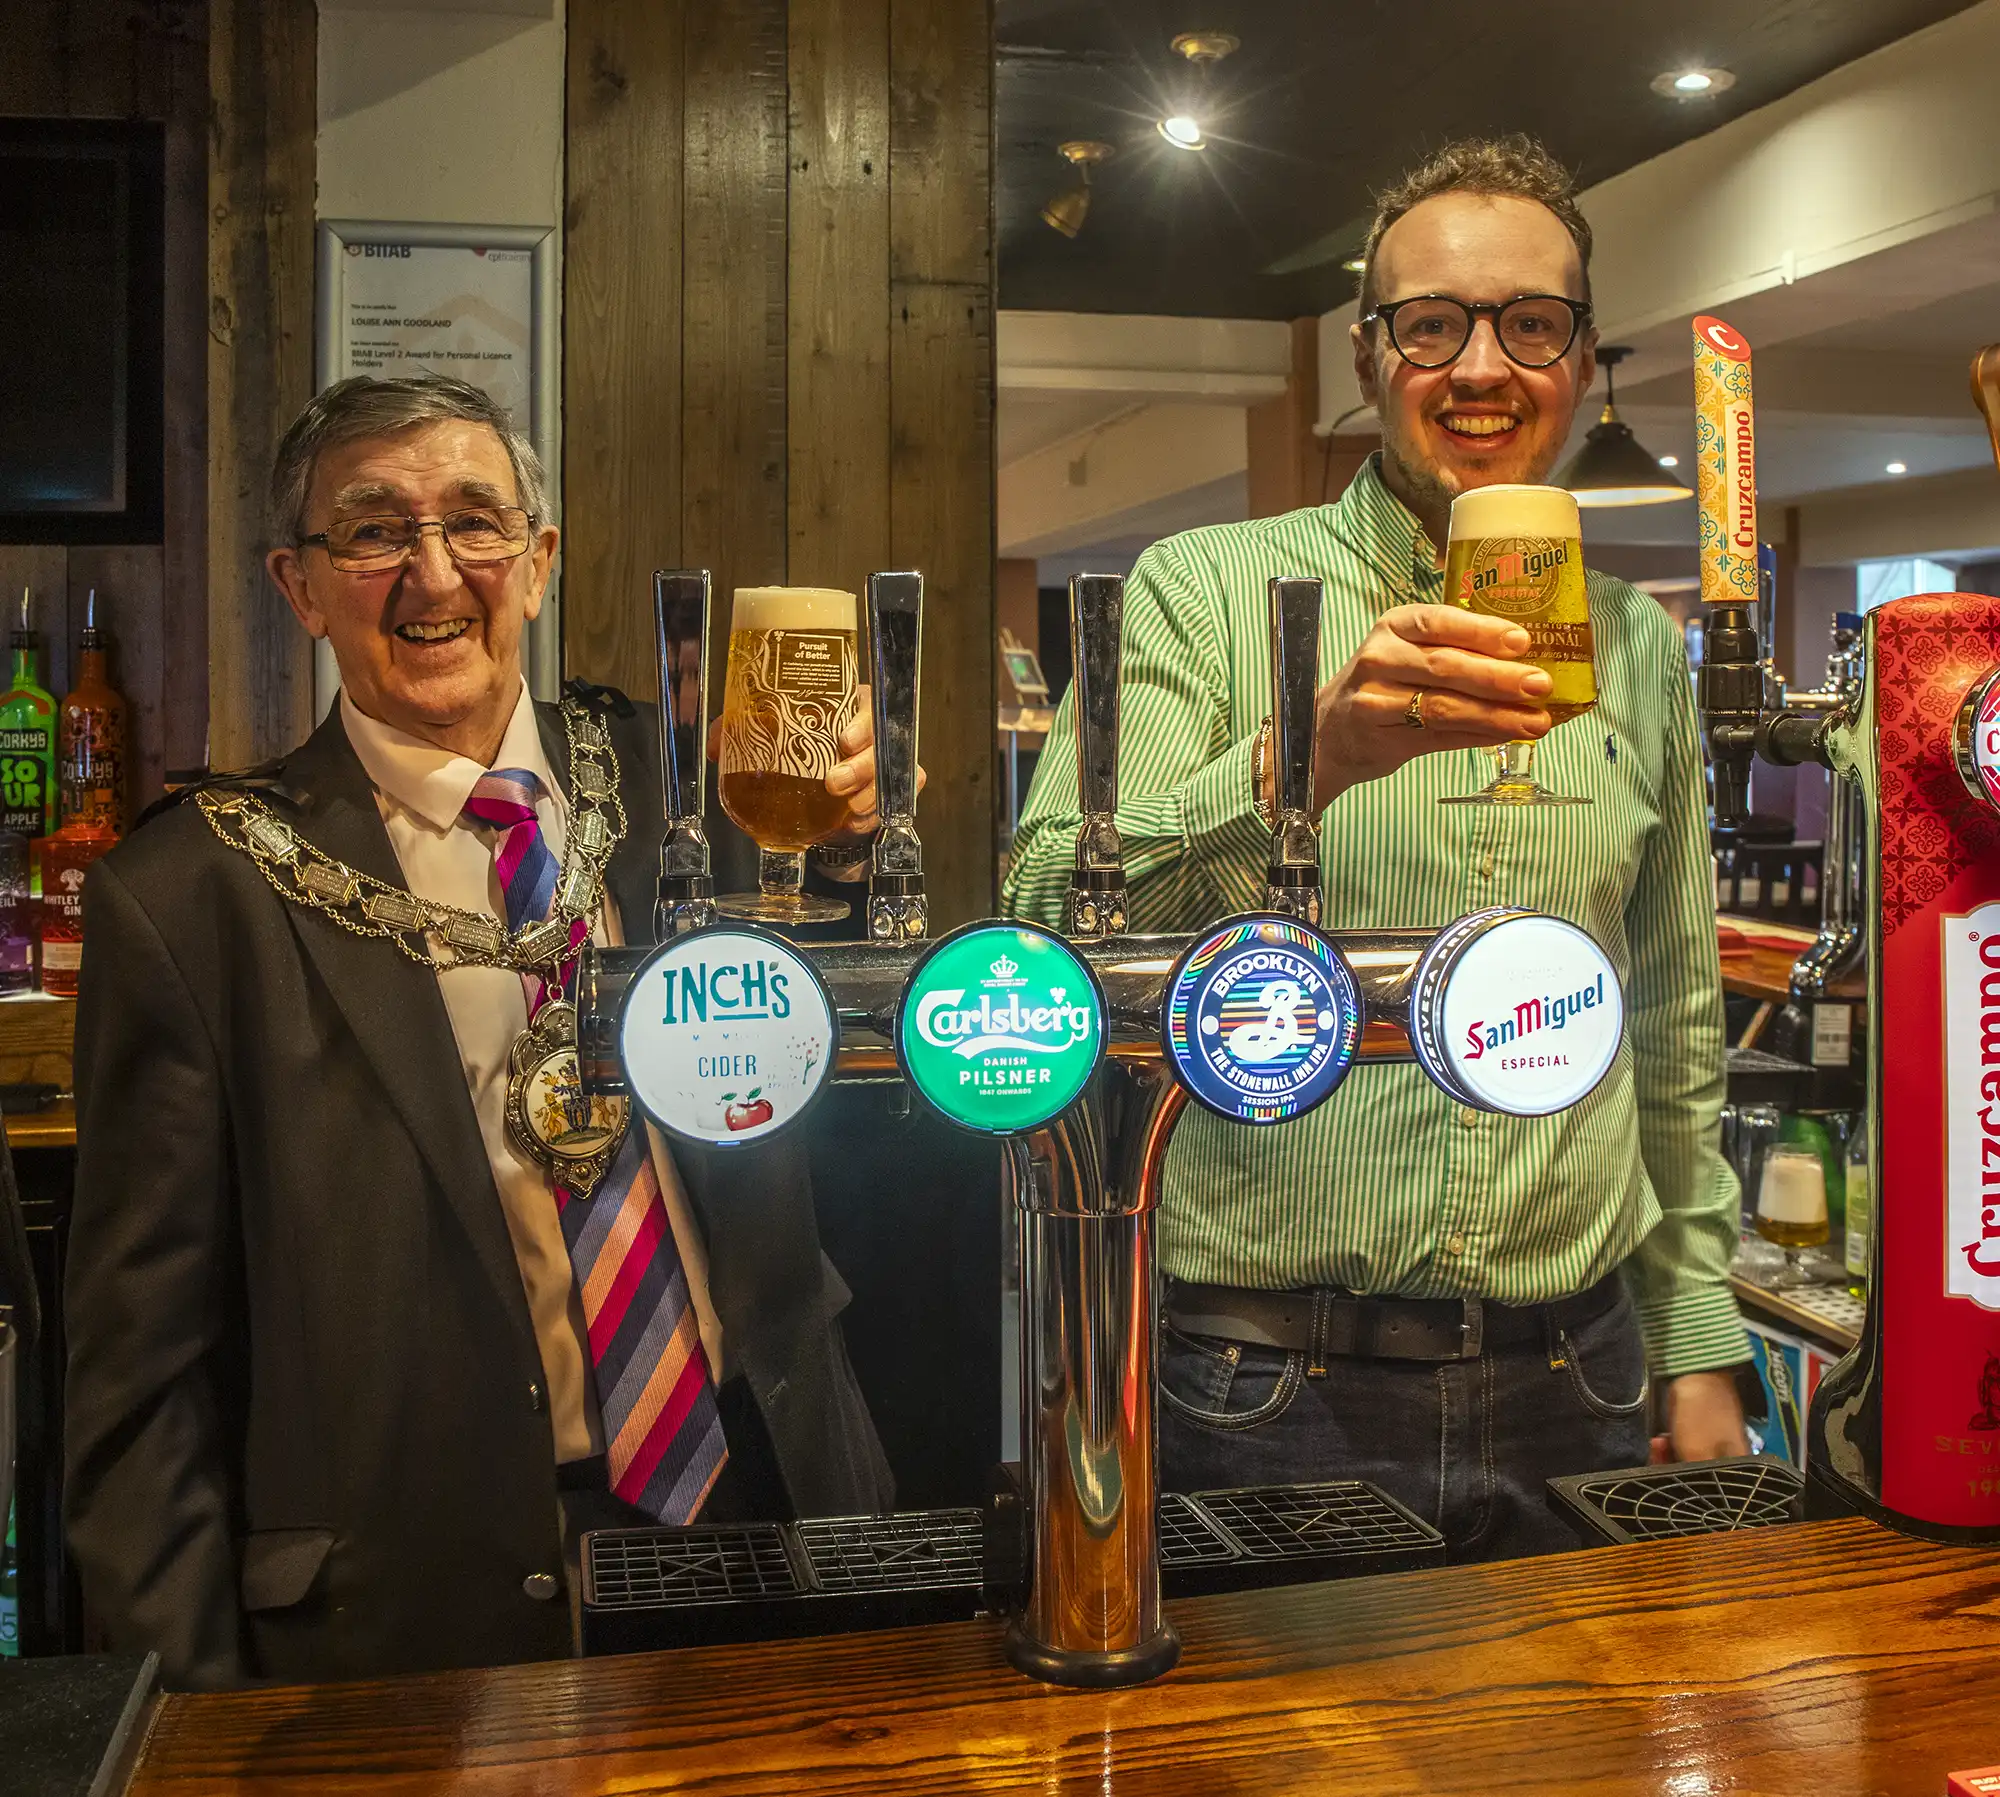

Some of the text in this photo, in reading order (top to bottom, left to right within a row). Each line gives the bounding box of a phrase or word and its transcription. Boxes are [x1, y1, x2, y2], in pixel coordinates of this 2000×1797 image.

[351, 317, 452, 328] LOUISE ANN GOODLAND
[374, 350, 396, 359] Level
[397, 351, 403, 359] 2
[405, 350, 431, 360] Award
[432, 351, 445, 360] for
[447, 351, 481, 361] Personal
[482, 352, 512, 361] Licence
[351, 359, 383, 369] Holders
[1735, 411, 1753, 548] Cruzcampo
[1492, 600, 1519, 613] SINCE
[799, 641, 828, 651] Pursuit
[794, 651, 831, 660] of Better
[3, 812, 40, 825] APPLE
[63, 905, 82, 916] GIN
[1211, 953, 1324, 999] BROOKLYN
[1420, 911, 1509, 1073] CERVEZA PREMIU
[915, 987, 1091, 1048] Carlsberg
[698, 1054, 757, 1078] CIDER
[983, 1056, 1028, 1067] DANISH
[1209, 1042, 1329, 1091] THE STONEWALL INN IPA
[1501, 1053, 1570, 1070] ESPECIAL
[959, 1067, 1052, 1085] PILSNER
[1241, 1094, 1296, 1106] SESSION IPA
